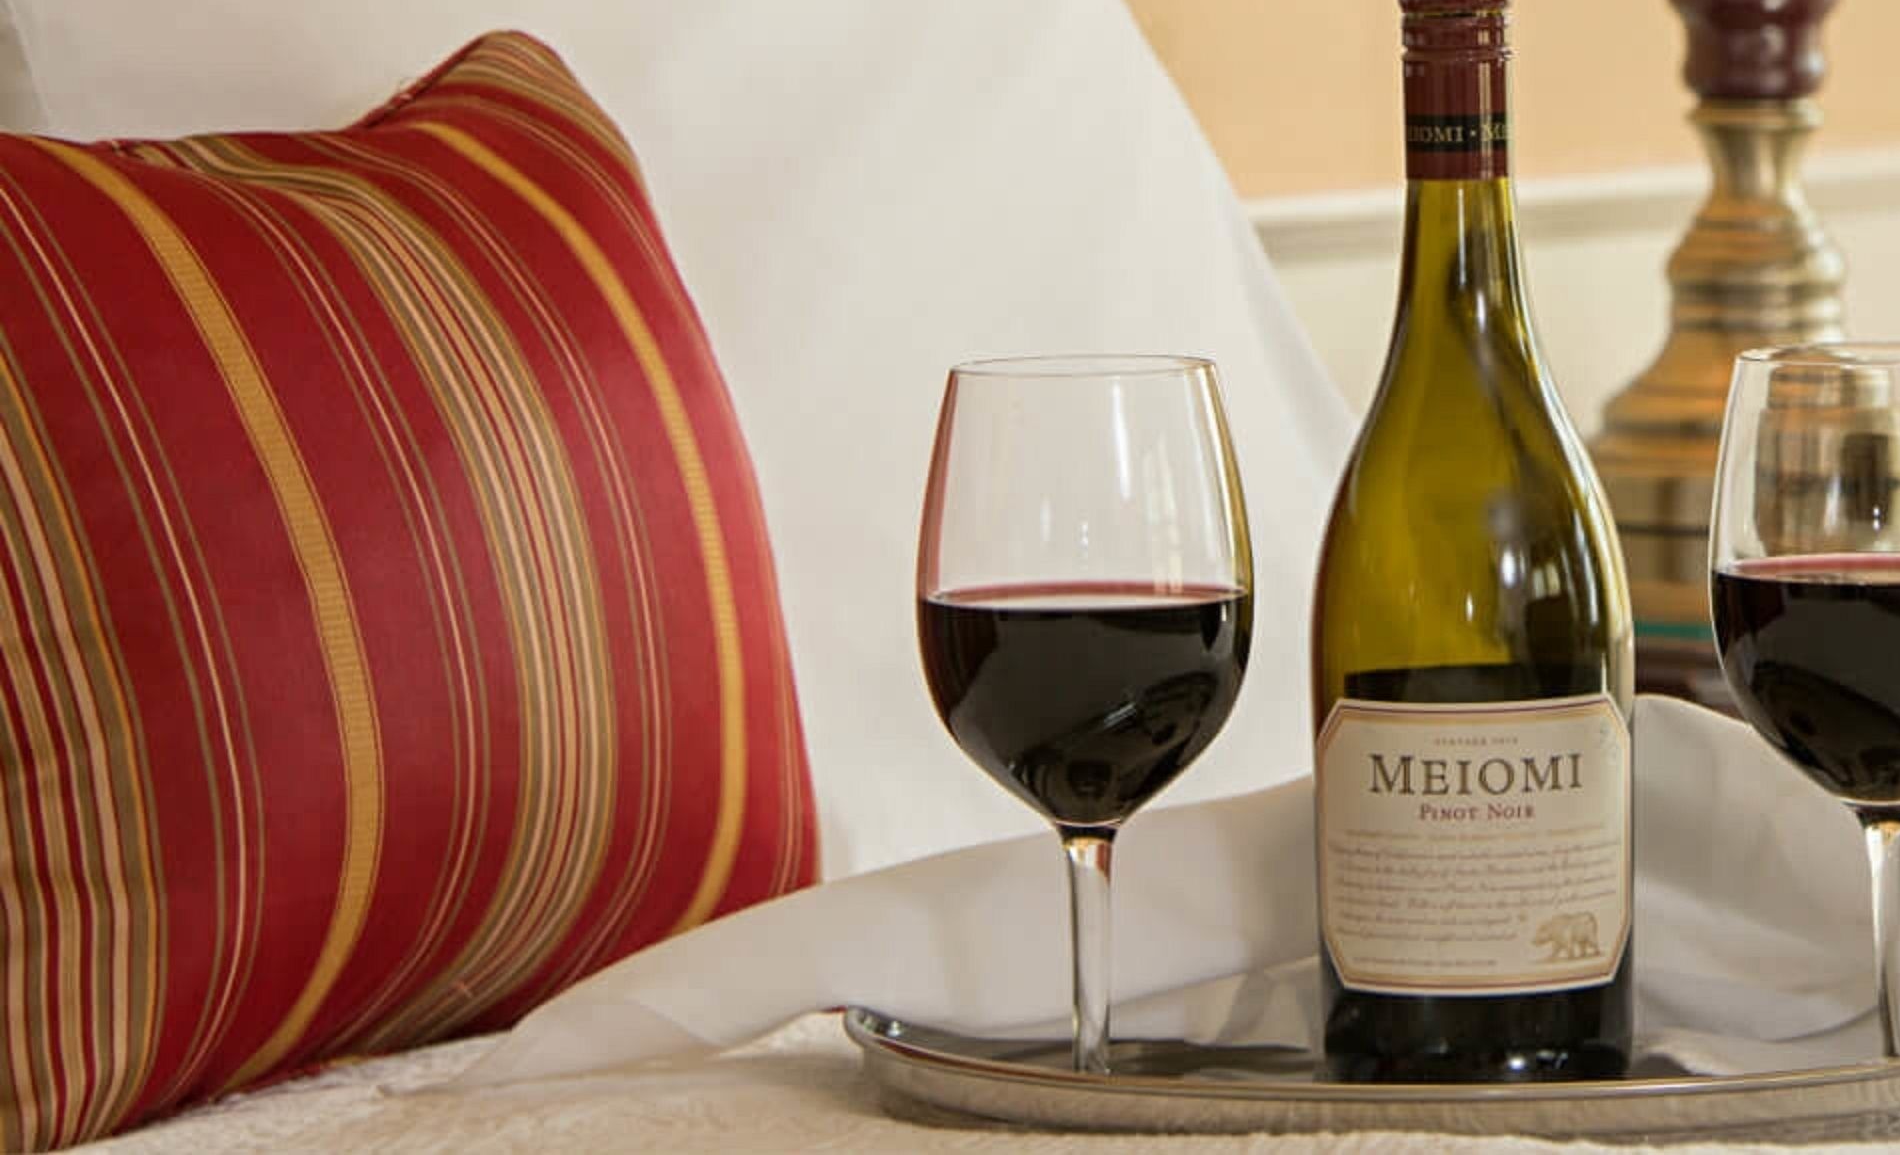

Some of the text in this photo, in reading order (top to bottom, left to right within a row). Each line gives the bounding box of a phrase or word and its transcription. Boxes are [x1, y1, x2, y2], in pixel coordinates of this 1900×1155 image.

[1369, 753, 1584, 796] MEIOMI
[1418, 801, 1535, 821] PINOT NOIR
